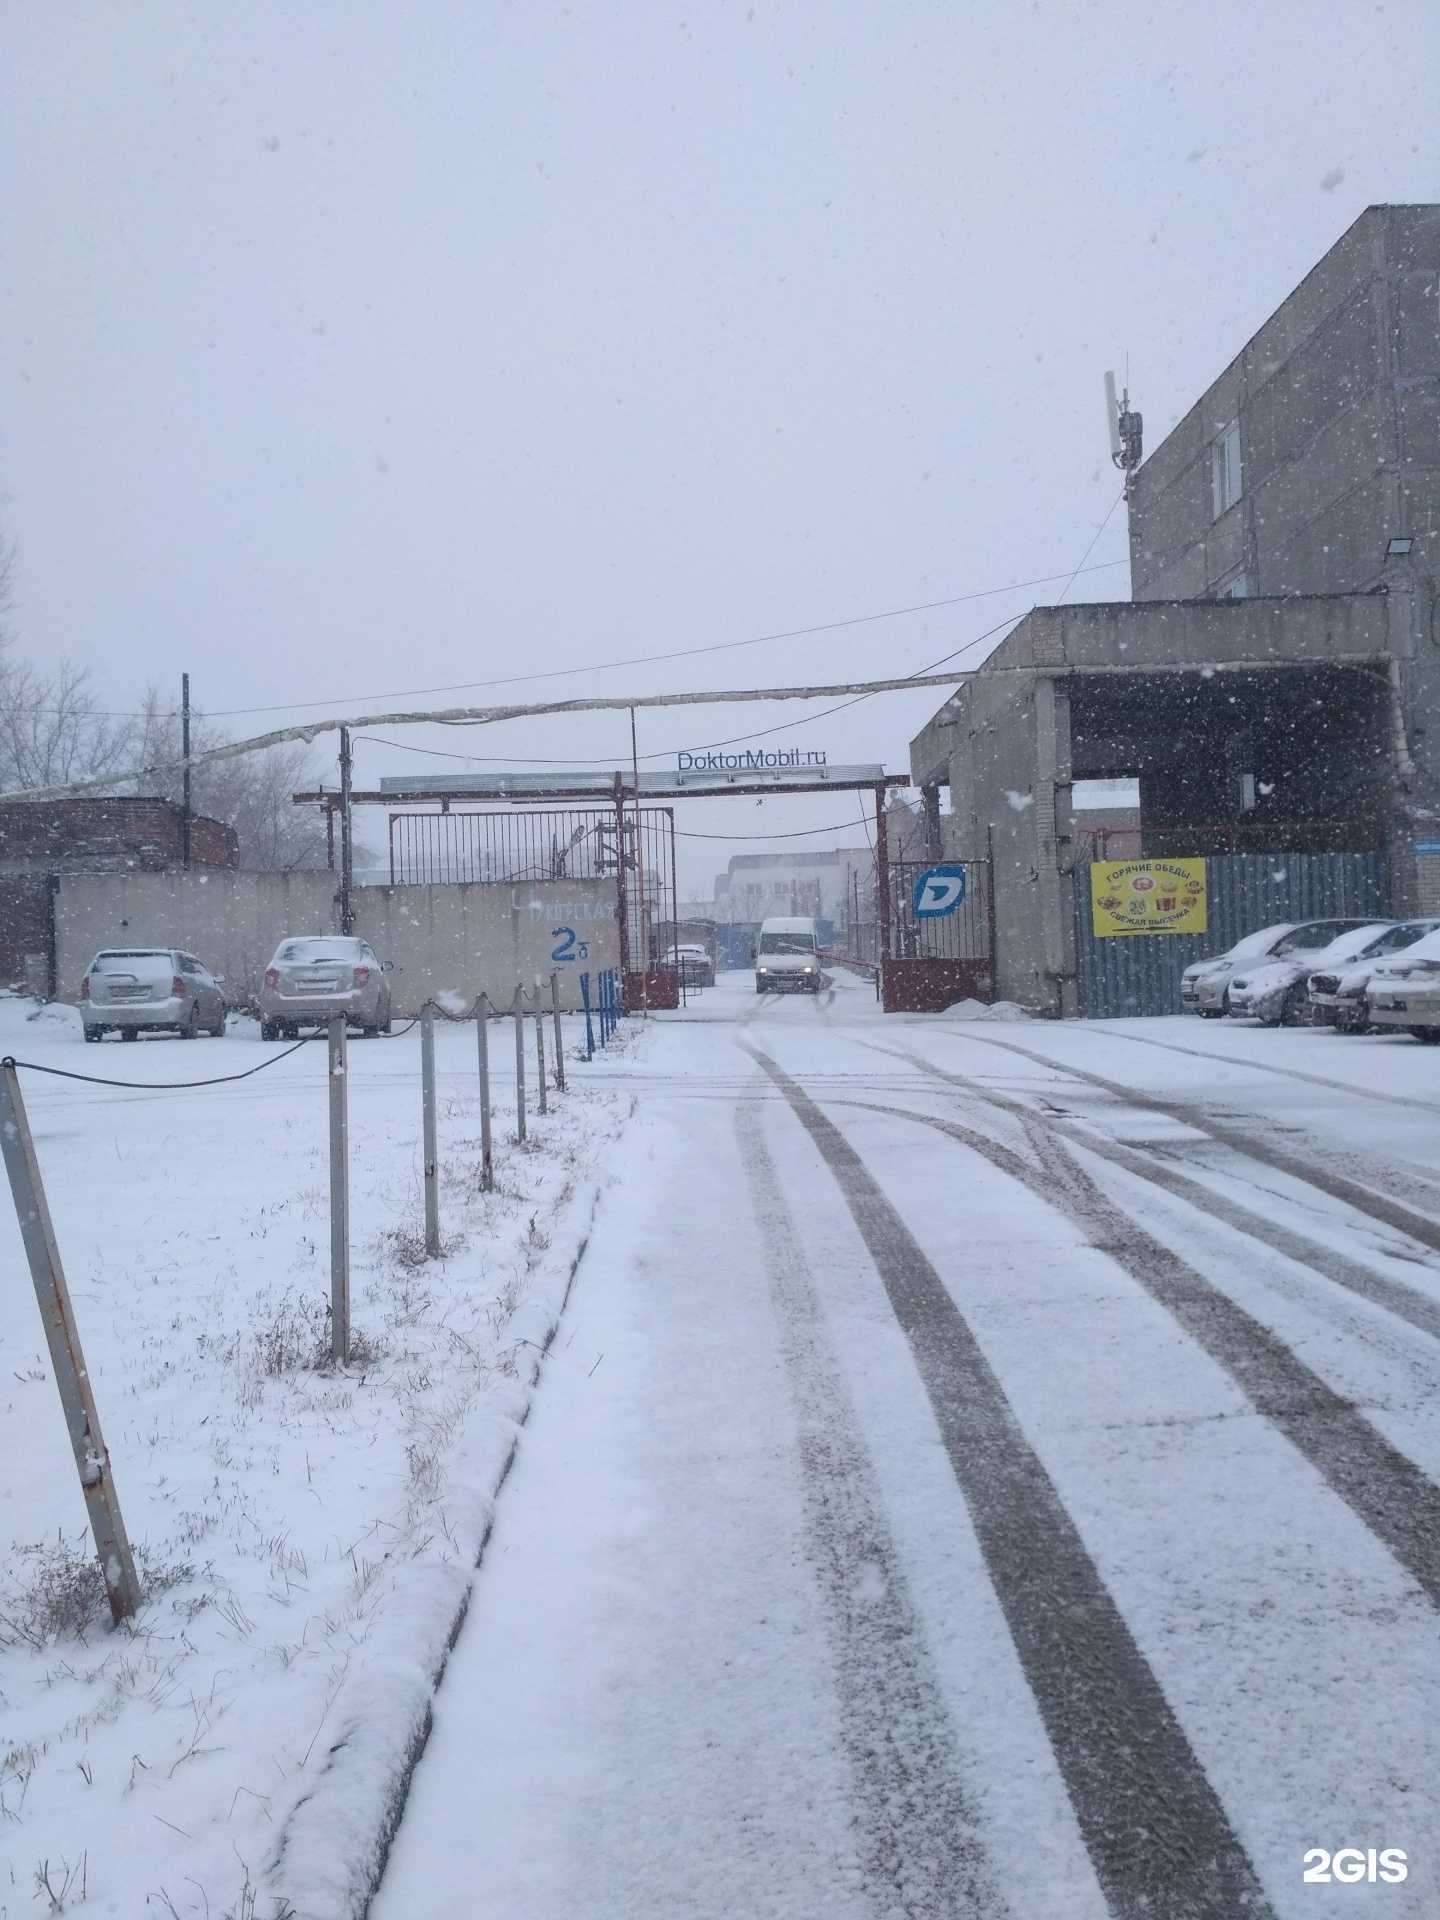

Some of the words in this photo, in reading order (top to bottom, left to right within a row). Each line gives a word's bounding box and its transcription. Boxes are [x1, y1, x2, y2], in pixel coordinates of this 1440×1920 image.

[678, 748, 826, 771] DoktorMobil.ru
[1106, 863, 1153, 882] ГОРЯЧИЕ
[1154, 863, 1191, 880] ОБЕДЫ
[1110, 911, 1147, 926] СВЕЖАЯ
